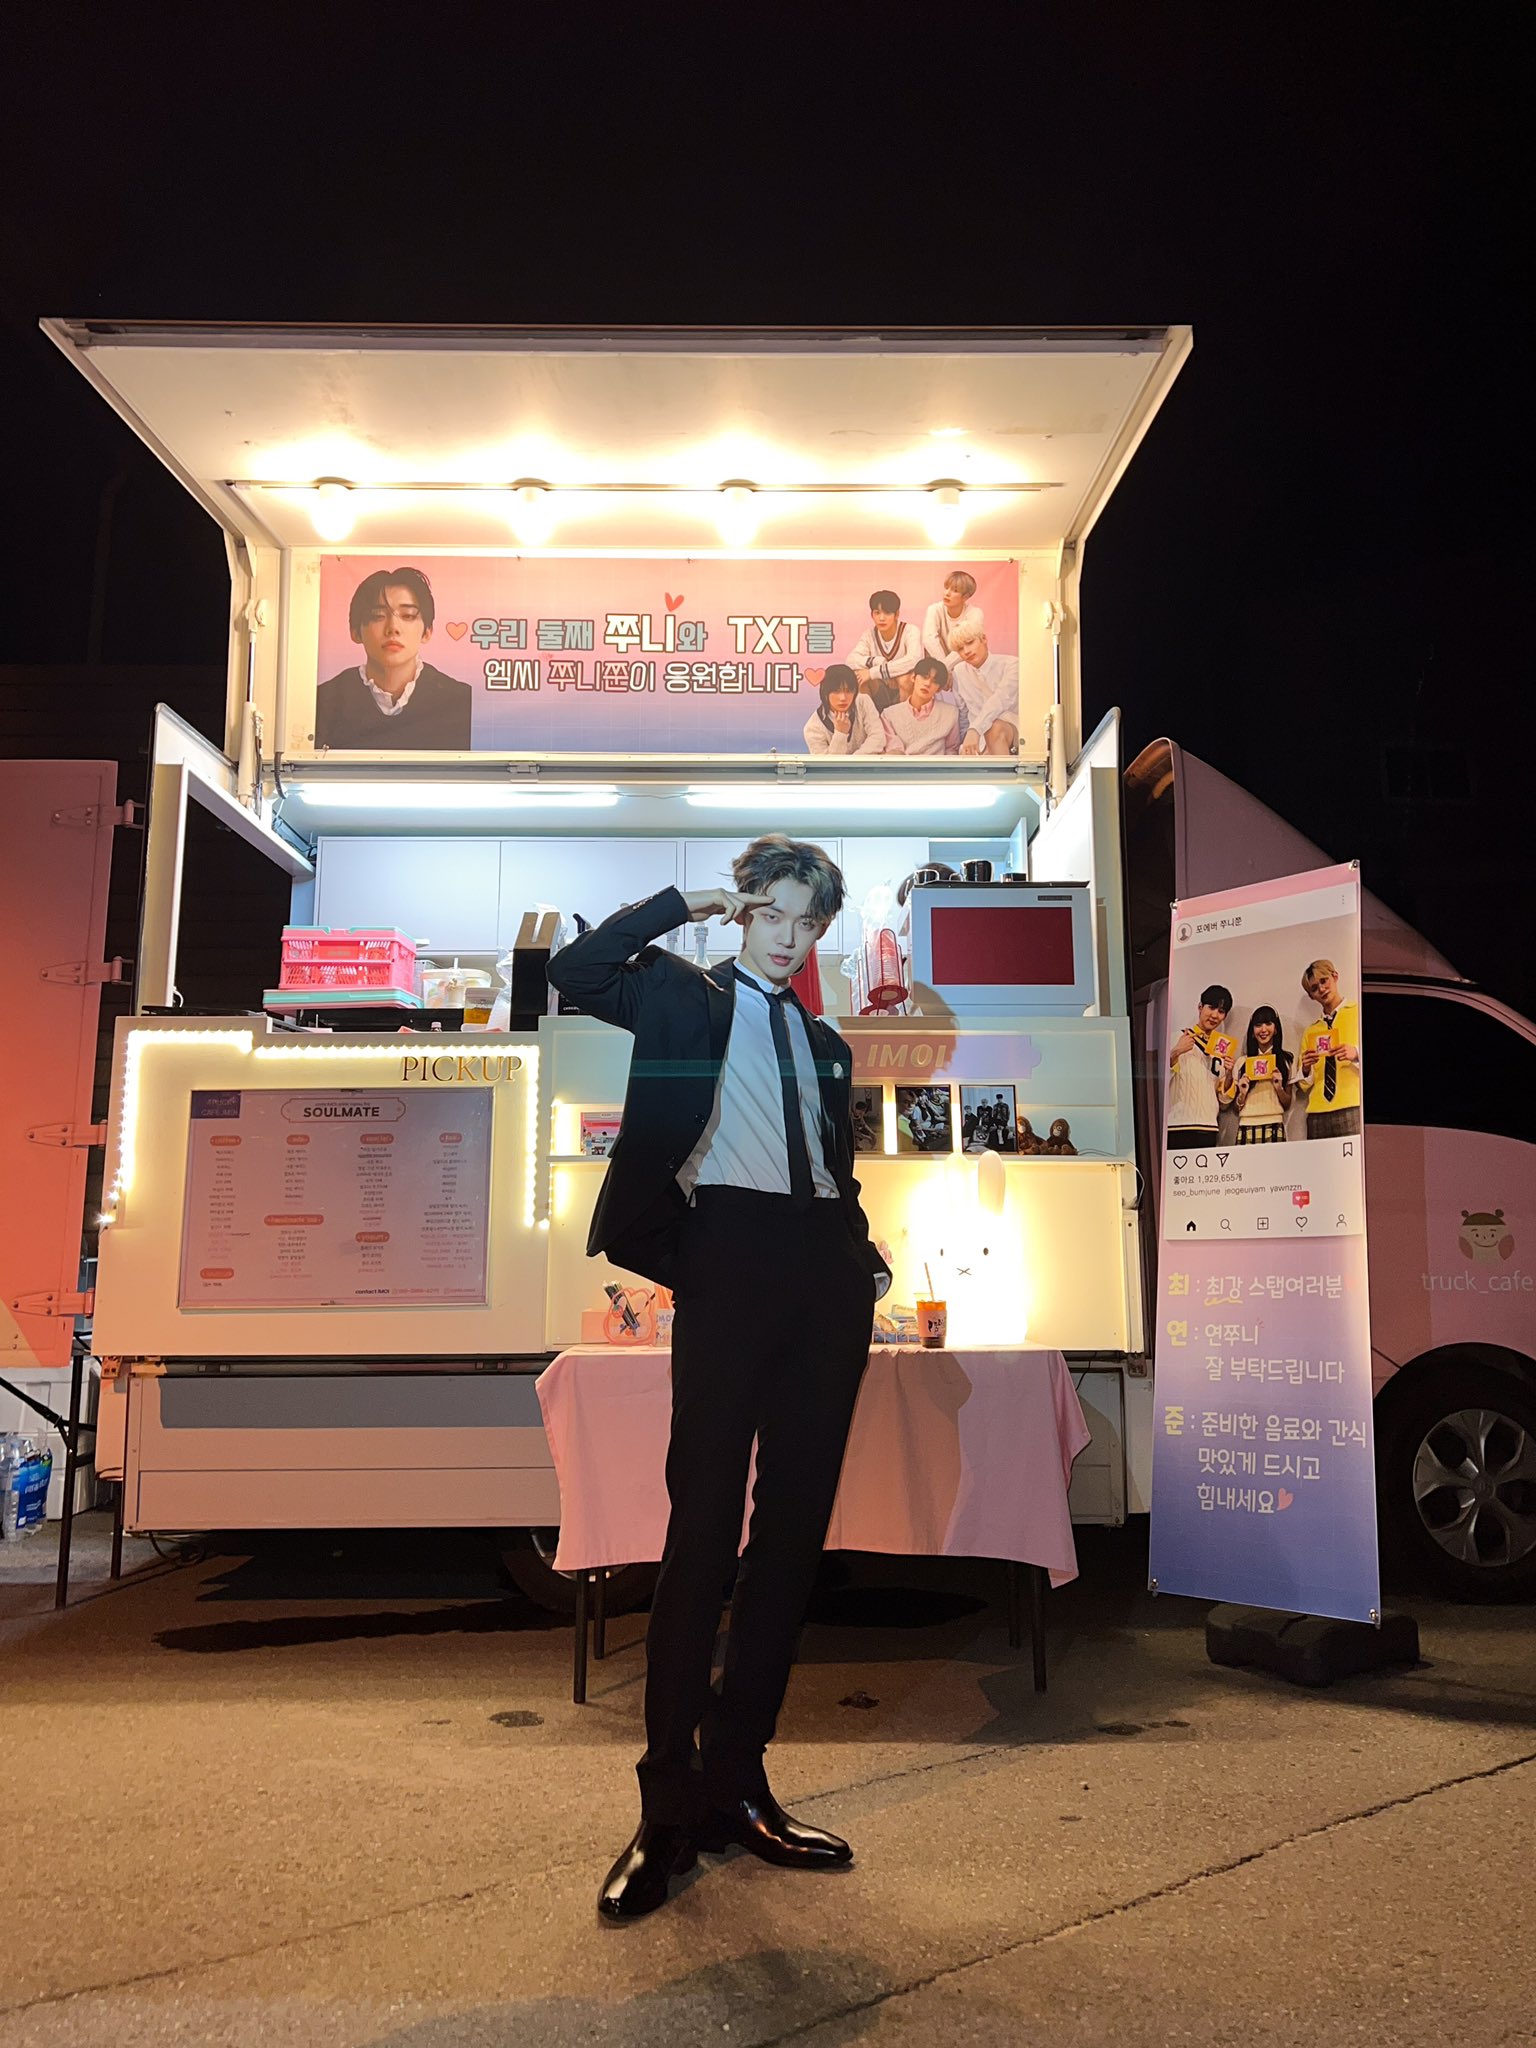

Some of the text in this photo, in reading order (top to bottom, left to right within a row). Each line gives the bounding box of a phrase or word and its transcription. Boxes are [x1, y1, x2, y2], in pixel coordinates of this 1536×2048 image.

[470, 614, 835, 654] 우리 둘째 쭈니와 TXT를
[484, 659, 541, 692] 엠씨
[664, 661, 803, 693] 응원합니다
[400, 1055, 523, 1081] PICKUP
[303, 1106, 380, 1118] SOULMATE
[1168, 1271, 1190, 1296] 최
[1206, 1275, 1243, 1299] 최강
[1249, 1274, 1343, 1299] 스탭여러분
[1167, 1319, 1188, 1346] 연
[1205, 1323, 1259, 1347] 연쭈니
[1205, 1356, 1346, 1385] 잘 부탁드립니다
[1164, 1406, 1185, 1436] 준
[1201, 1411, 1259, 1440] 준비한
[1265, 1415, 1322, 1442] 음료와
[1328, 1420, 1366, 1448] 간식
[1198, 1447, 1320, 1480] 맛있게 드시고
[1197, 1482, 1275, 1514] 힘내세요
